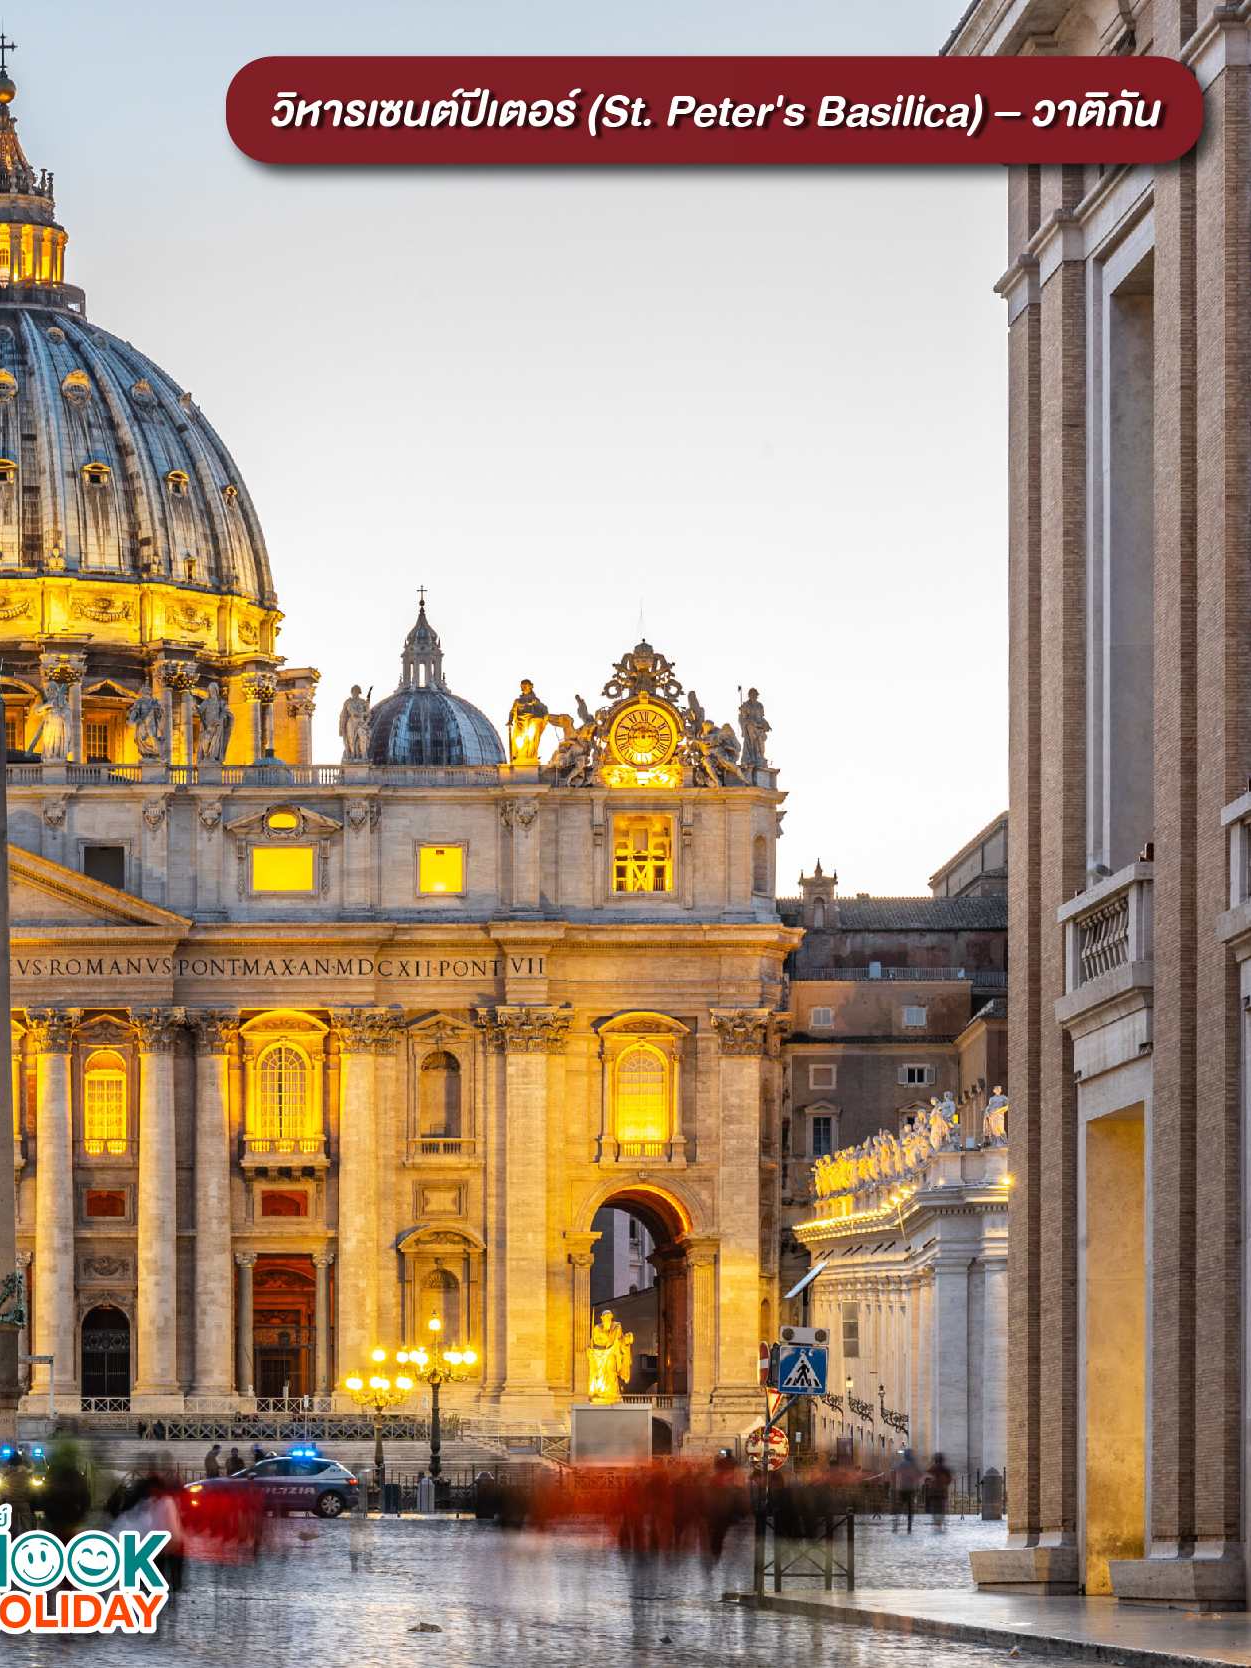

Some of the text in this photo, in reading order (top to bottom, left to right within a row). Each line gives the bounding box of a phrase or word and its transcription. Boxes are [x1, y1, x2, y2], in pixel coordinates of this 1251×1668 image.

[49, 957, 172, 977] ROMANVS
[178, 958, 241, 977] PONT
[241, 958, 295, 976] MAX
[297, 958, 332, 976] AN
[336, 957, 432, 977] MDCXII
[438, 959, 504, 978] PONT
[511, 957, 544, 976] VII
[258, 1486, 317, 1495] OLIZIA
